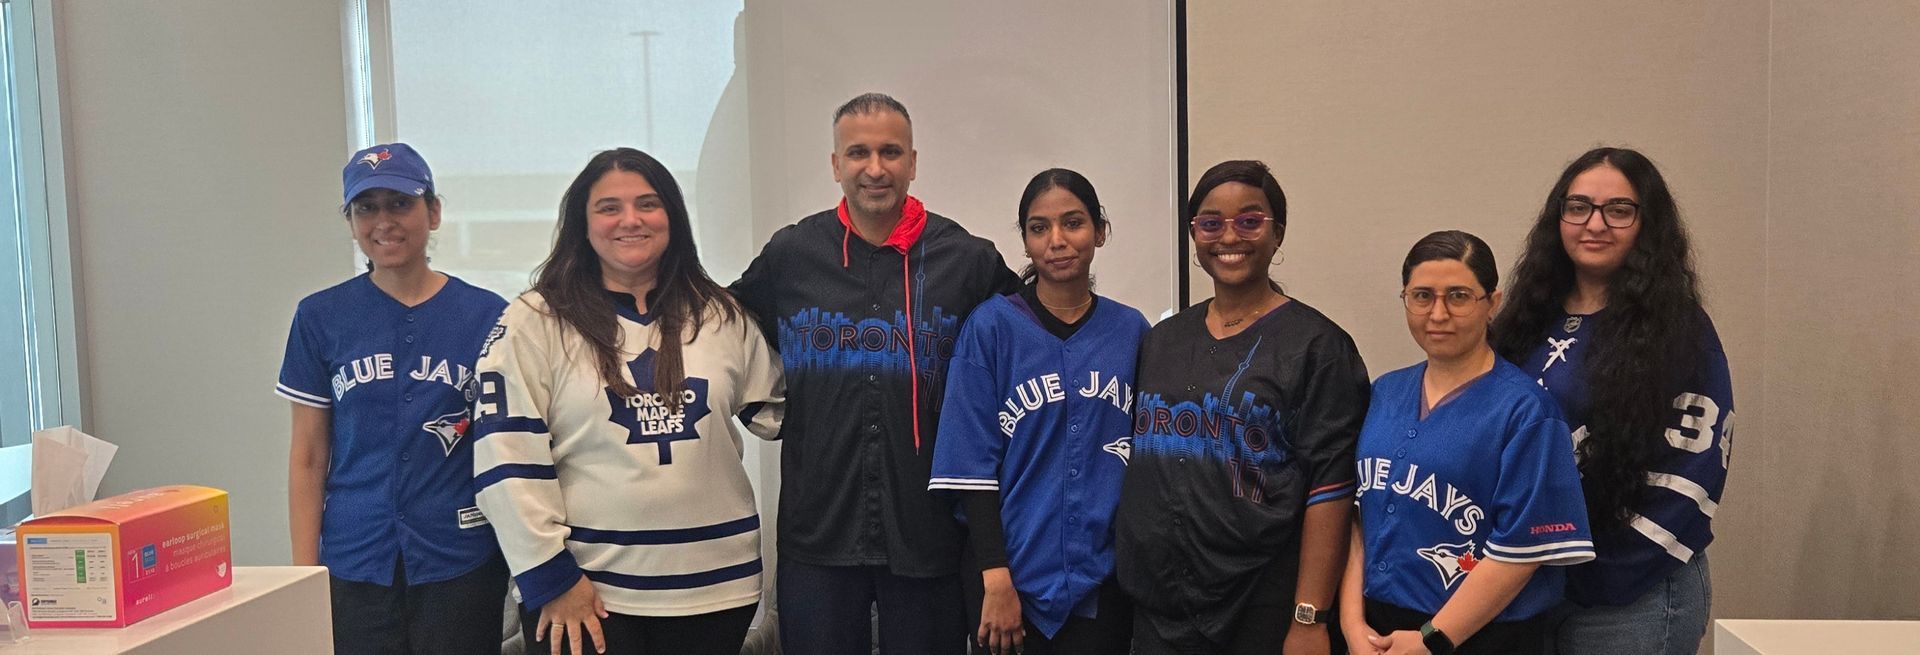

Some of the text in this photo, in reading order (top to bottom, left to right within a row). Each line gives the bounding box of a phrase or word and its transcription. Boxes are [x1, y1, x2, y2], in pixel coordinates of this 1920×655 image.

[798, 324, 955, 360] TORONTO
[331, 353, 480, 402] BLUE JAYS
[636, 404, 686, 422] MAPLE
[998, 370, 1133, 439] BLUE JAY
[640, 418, 684, 436] LEAFS
[1135, 406, 1268, 451] ORONTO
[1229, 456, 1267, 504] 17
[1391, 463, 1485, 536] JAYS
[161, 522, 225, 549] earloop surgical mask
[1530, 522, 1577, 535] HONDA
